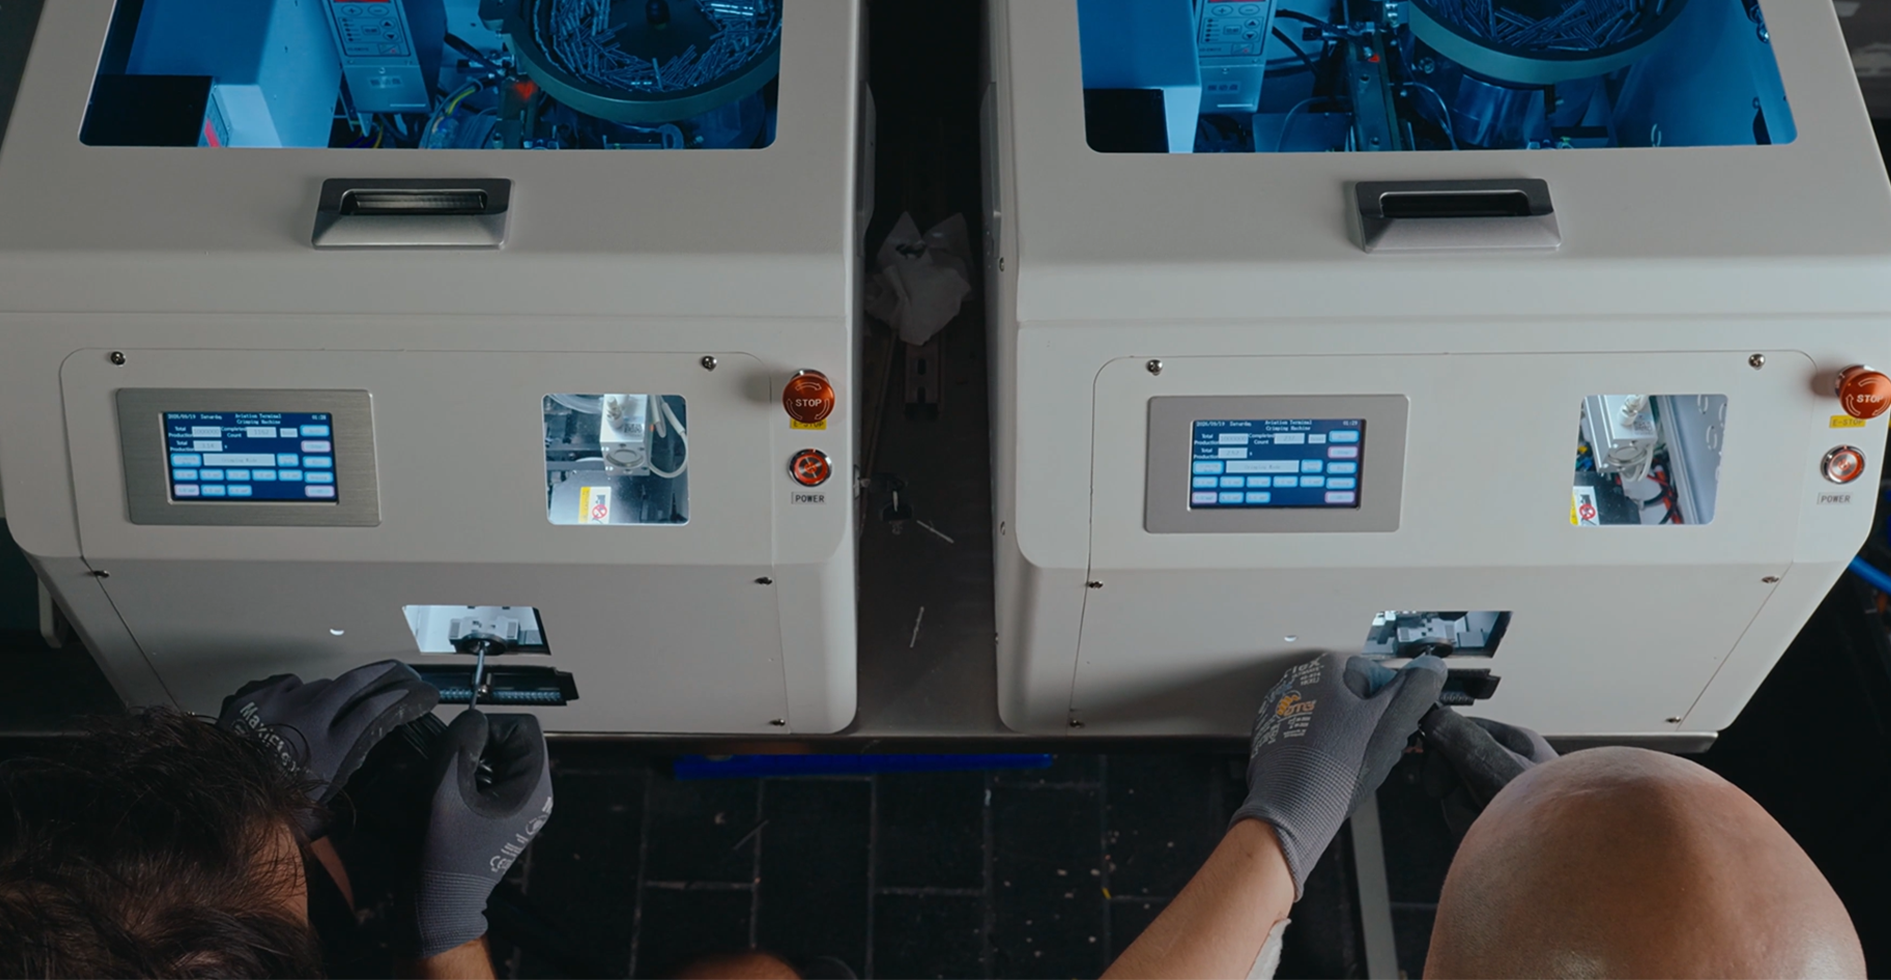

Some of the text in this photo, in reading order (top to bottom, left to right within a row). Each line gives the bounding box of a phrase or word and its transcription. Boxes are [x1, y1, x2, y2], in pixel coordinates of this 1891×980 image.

[795, 399, 822, 407] STOP
[1857, 395, 1884, 403] STOP
[795, 495, 825, 503] POWER
[1820, 495, 1851, 503] POWER
